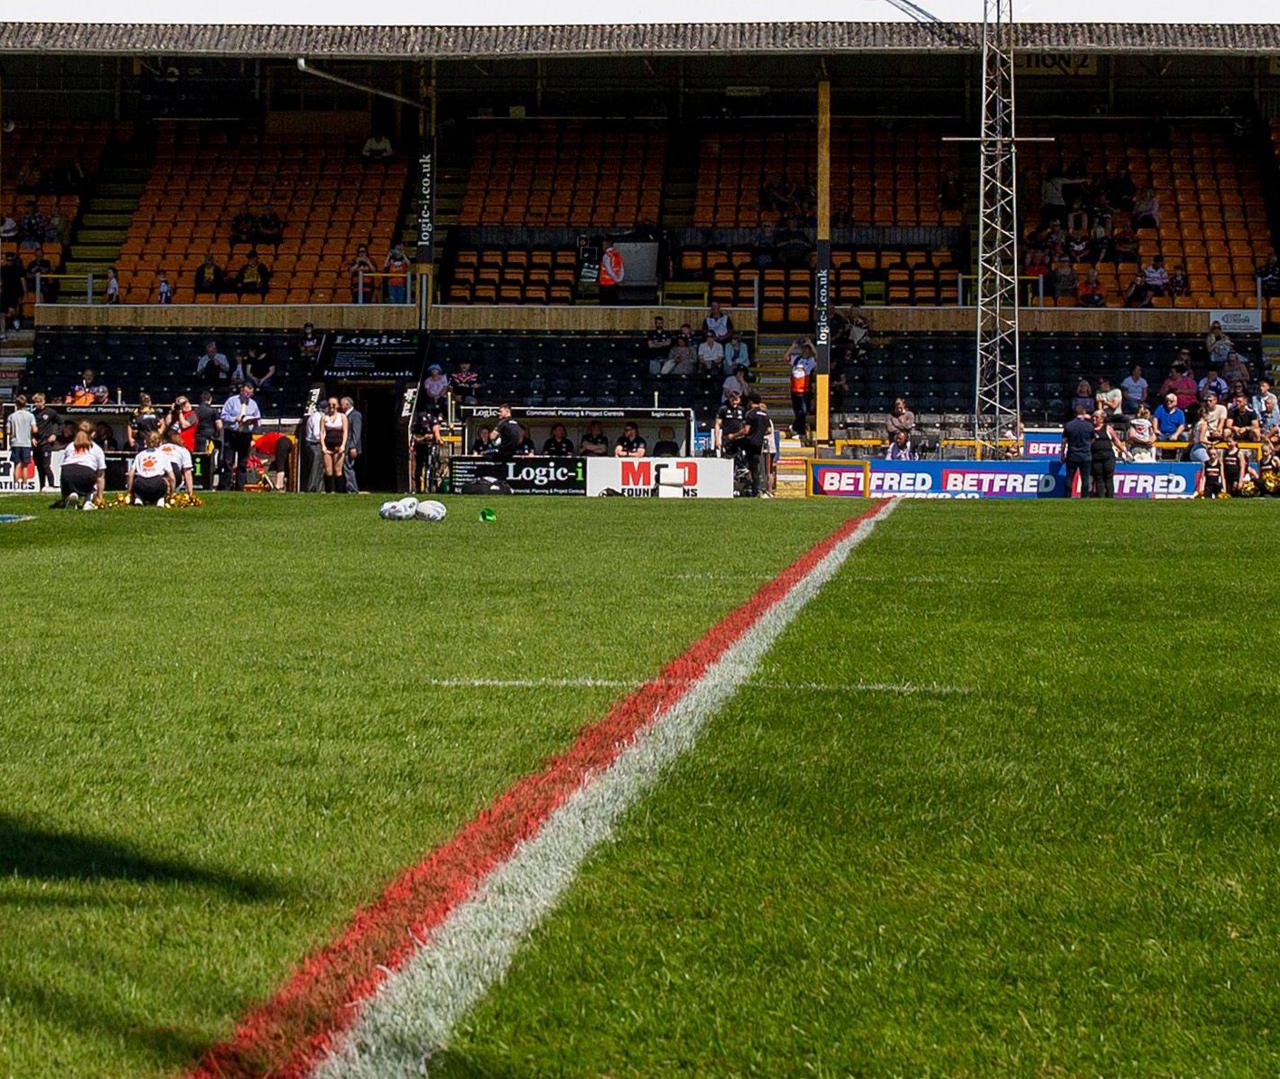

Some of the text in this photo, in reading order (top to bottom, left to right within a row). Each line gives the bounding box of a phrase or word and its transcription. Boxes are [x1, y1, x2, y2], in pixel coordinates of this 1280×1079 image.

[417, 154, 433, 246] logic-i.co.uk
[816, 269, 830, 345] logic-i.co.uk
[472, 409, 501, 418] Logic-
[506, 462, 585, 486] Logic-i
[823, 471, 932, 491] BETFRED
[947, 473, 1056, 493] BETFRED
